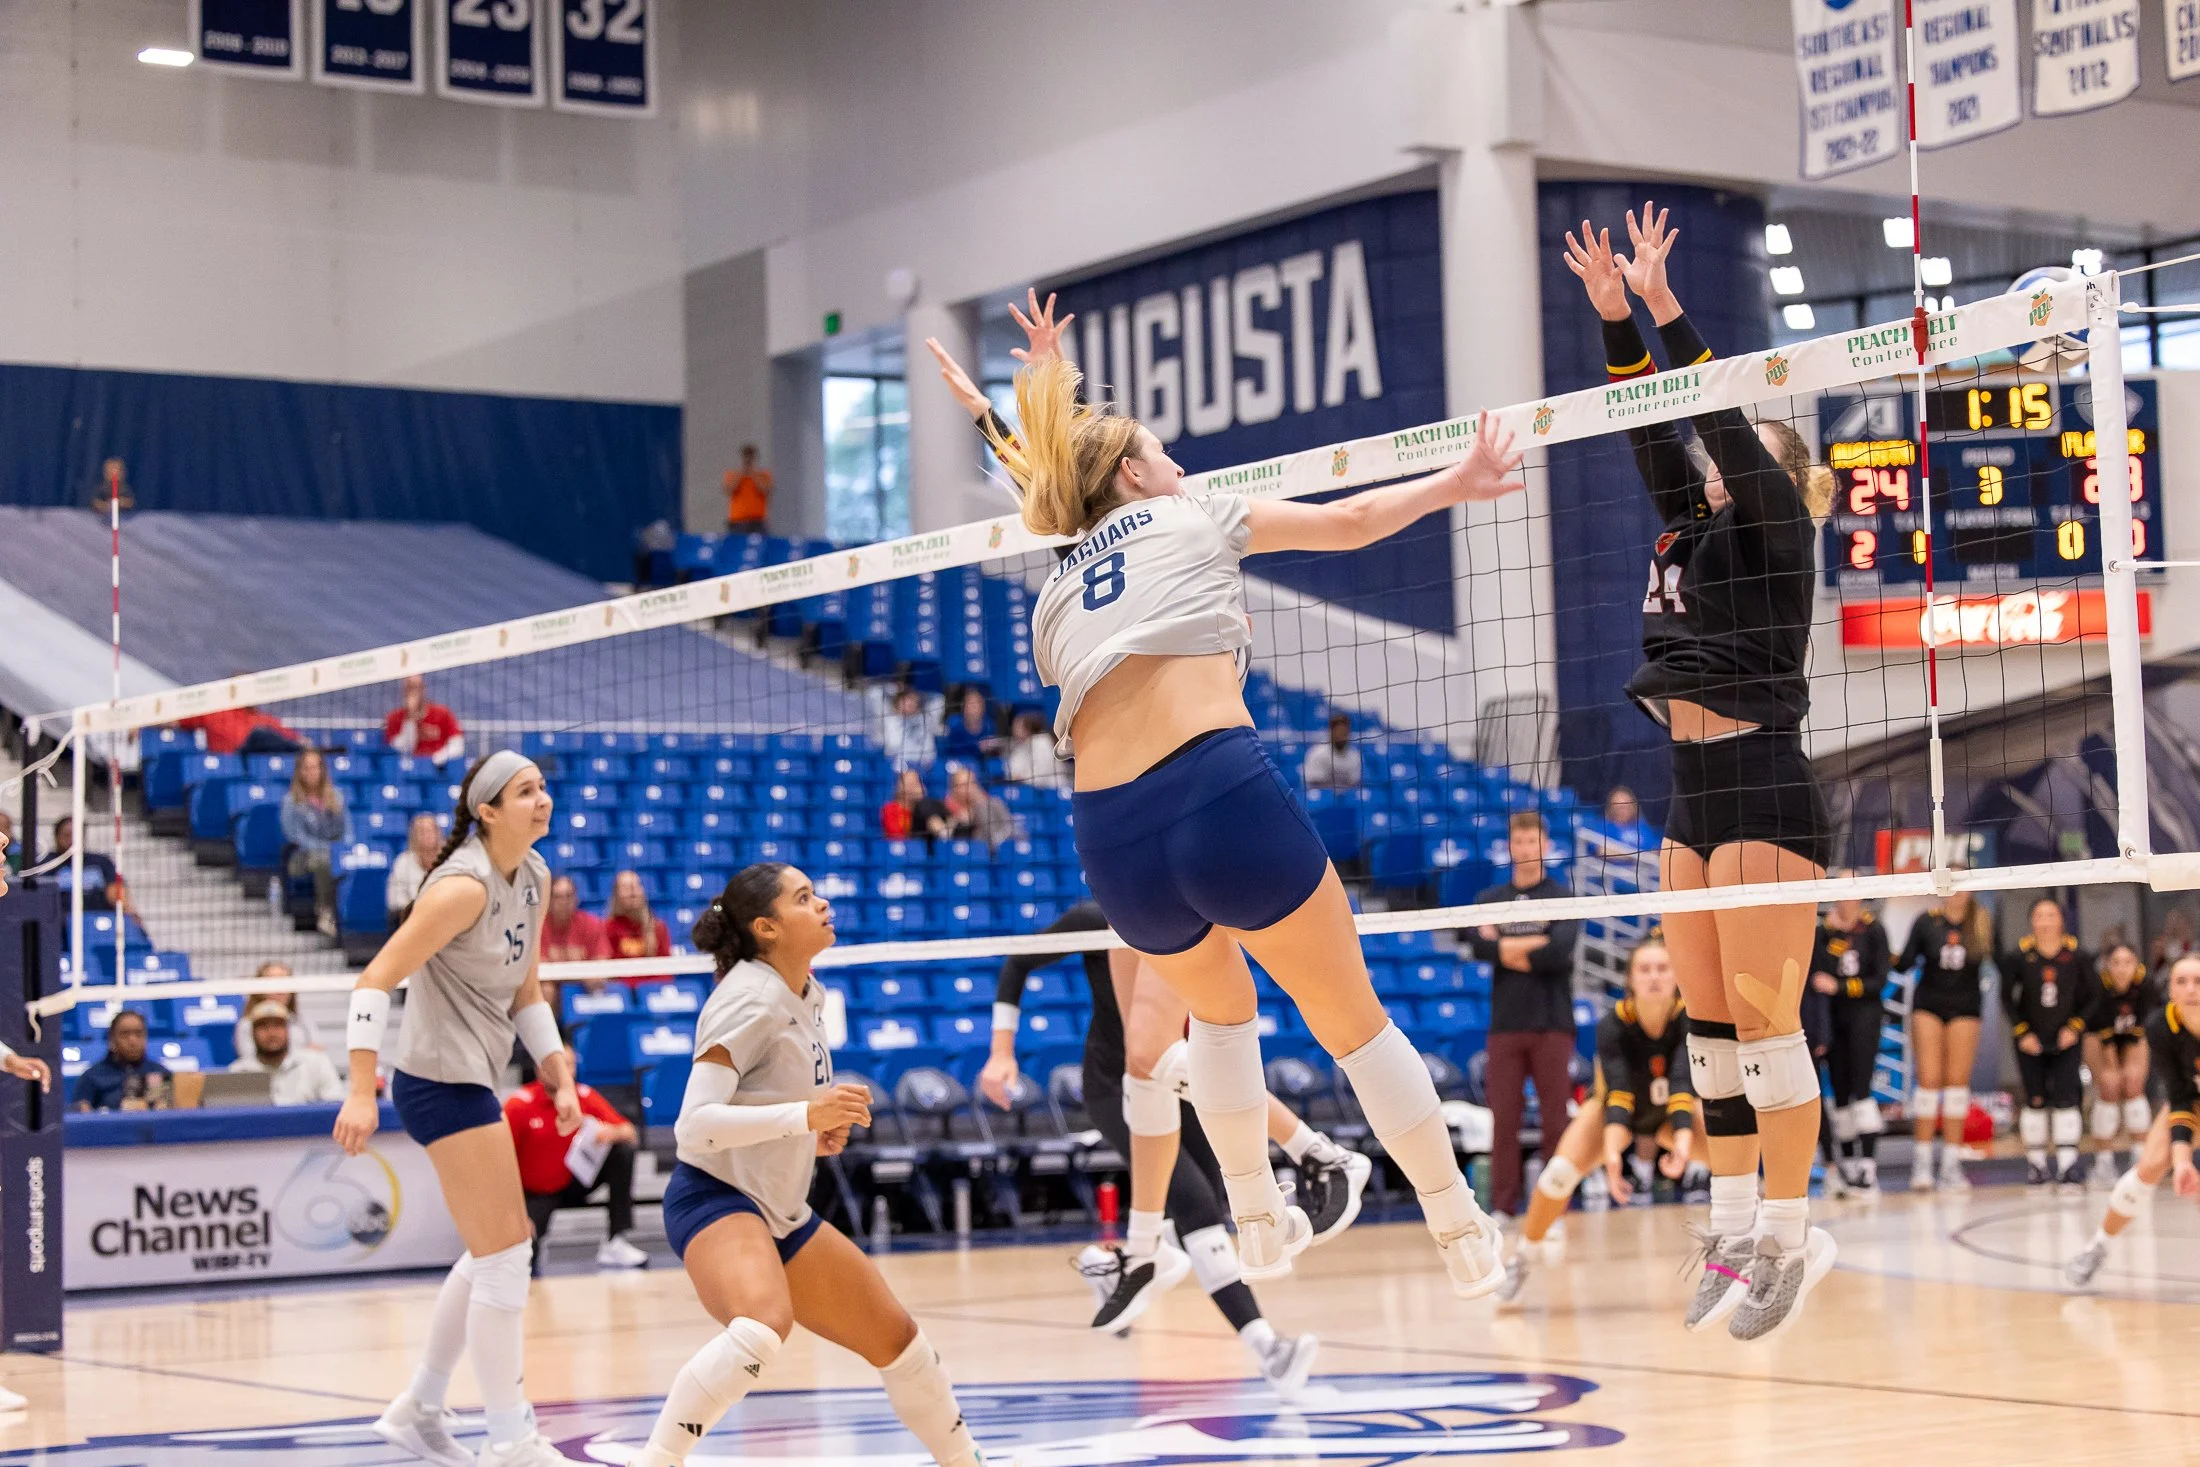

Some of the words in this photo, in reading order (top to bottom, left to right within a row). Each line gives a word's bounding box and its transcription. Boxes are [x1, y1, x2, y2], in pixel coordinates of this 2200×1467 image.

[1847, 326, 1909, 353] PEACH
[1929, 313, 1958, 336] ELT
[1851, 336, 1958, 368] Confernce
[1606, 381, 1657, 406] PEACH
[1662, 372, 1702, 394] BELT
[1765, 358, 1790, 386] PBC
[1608, 392, 1702, 419] Conference
[1967, 383, 2052, 430] 1:15
[1394, 427, 1442, 449] PEACH
[1397, 439, 1472, 462] Conferenc
[1252, 463, 1283, 481] BELT
[1850, 467, 1909, 515] 24
[1978, 465, 2003, 505] 3
[1053, 509, 1154, 583] JAGUARS
[1851, 529, 1876, 569] 2
[2057, 520, 2085, 560] 0
[1082, 551, 1126, 612] 8
[504, 922, 526, 966] 15
[133, 1184, 259, 1220] News
[90, 1211, 271, 1259] Channel
